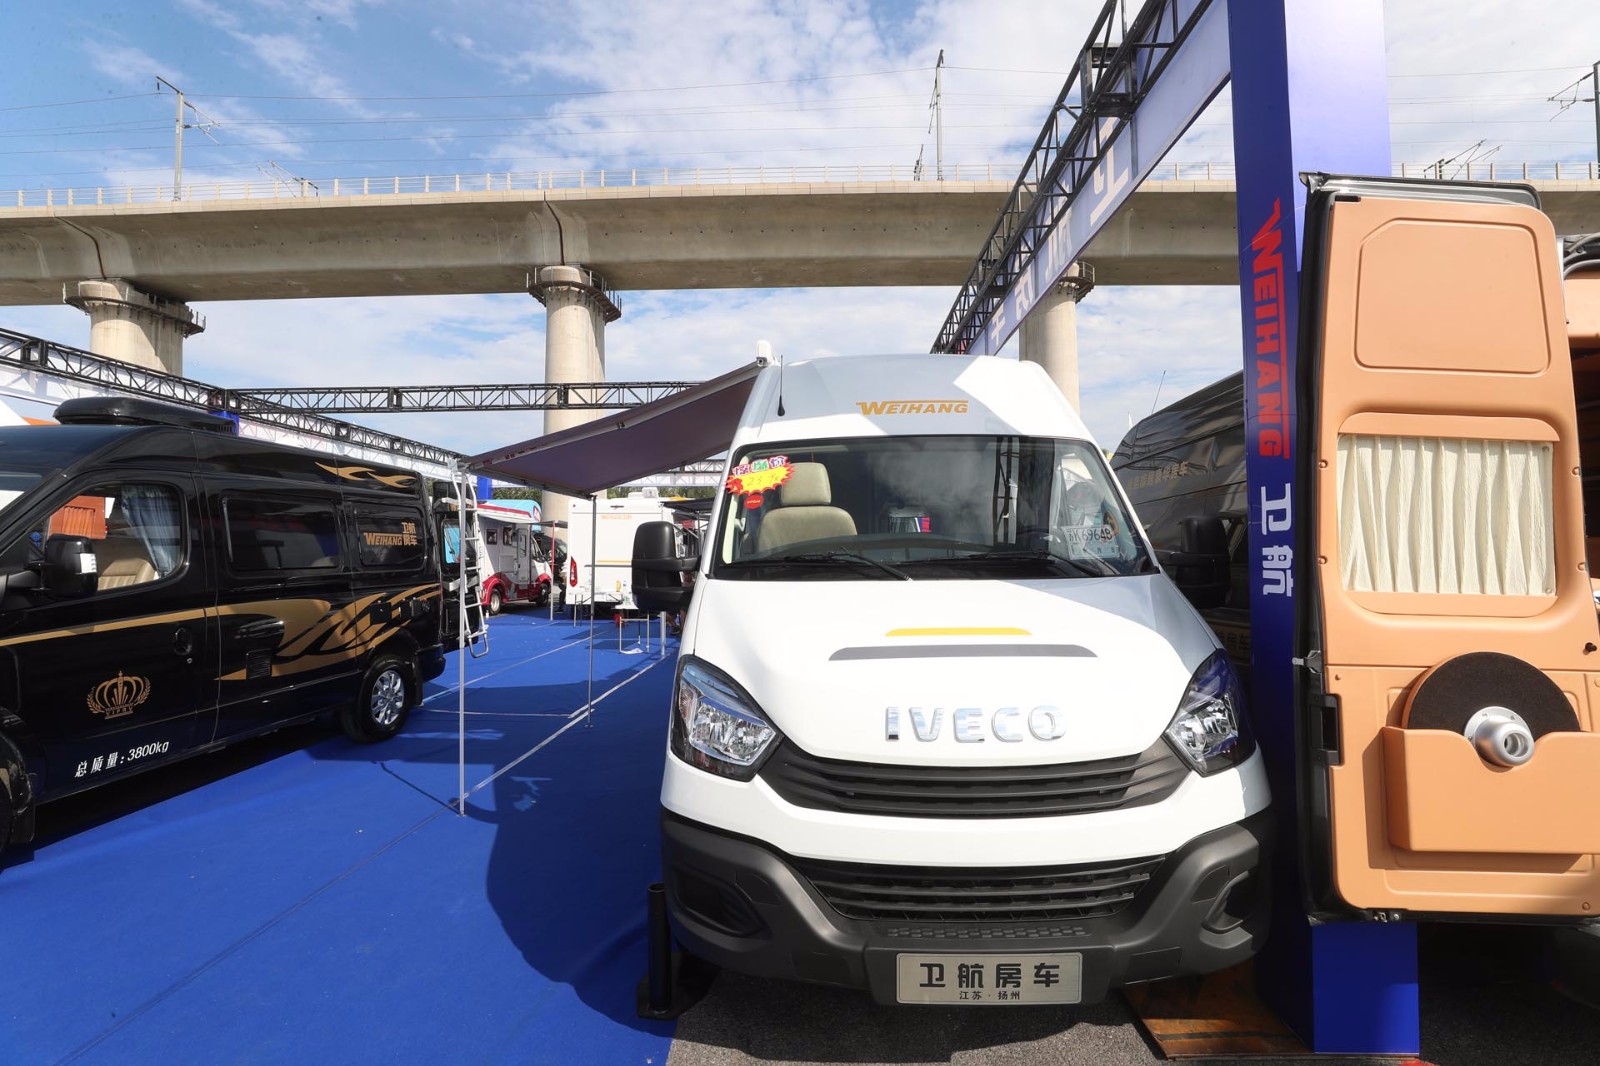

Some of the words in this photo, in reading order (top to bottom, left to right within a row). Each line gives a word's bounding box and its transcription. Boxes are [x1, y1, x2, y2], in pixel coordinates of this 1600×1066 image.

[1251, 197, 1290, 459] WEIHANG
[856, 400, 968, 415] WEIHANG
[363, 532, 402, 546] WEIHANG
[1260, 482, 1294, 597] 卫航
[885, 704, 1067, 743] IVECO
[919, 962, 1060, 989] 卫航房车
